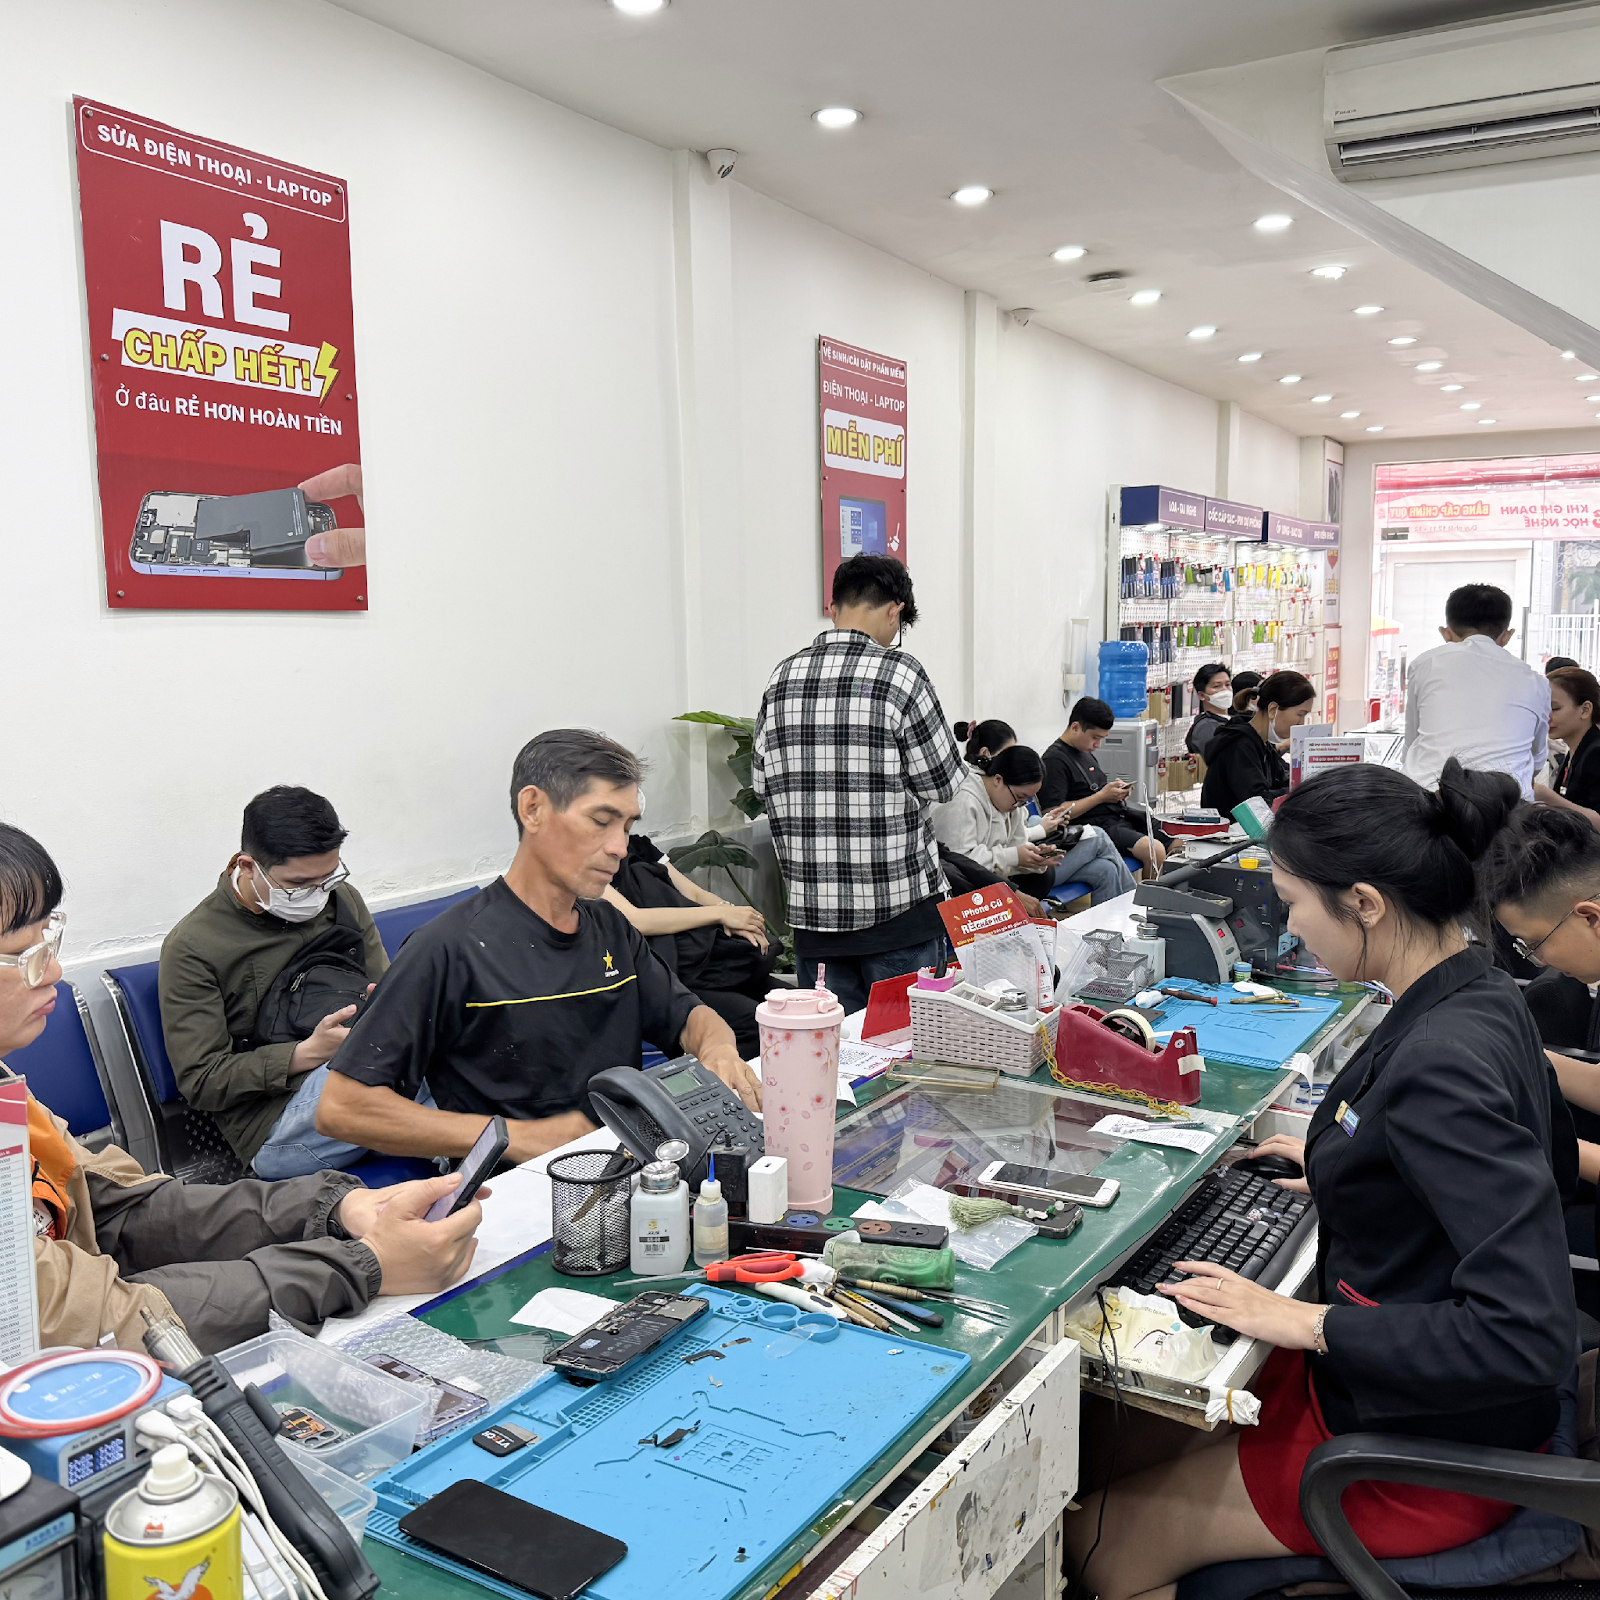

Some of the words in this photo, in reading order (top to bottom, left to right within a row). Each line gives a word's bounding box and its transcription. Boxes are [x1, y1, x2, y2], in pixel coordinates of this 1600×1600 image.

[98, 124, 140, 152] SỬA
[144, 138, 192, 167] ĐIỆN
[195, 154, 252, 186] THOẠI
[267, 175, 332, 207] LAPTOP
[160, 212, 290, 332] RẺ
[124, 328, 227, 376] CHẤP
[234, 344, 311, 390] HẾT!
[115, 383, 130, 407] Ở
[136, 391, 170, 413] đâu
[175, 394, 200, 417] RẺ
[204, 401, 245, 423] HƠN
[250, 408, 300, 430] HOÀN
[304, 413, 343, 436] TIỀN
[823, 380, 843, 399] ĐIỆN
[844, 386, 868, 407] THOẠI
[874, 394, 905, 412] LAPTOP
[827, 420, 870, 462] MIỄN
[873, 434, 904, 467] PHÍ
[962, 905, 989, 919] iPhone
[482, 1431, 510, 1448] VTECH
